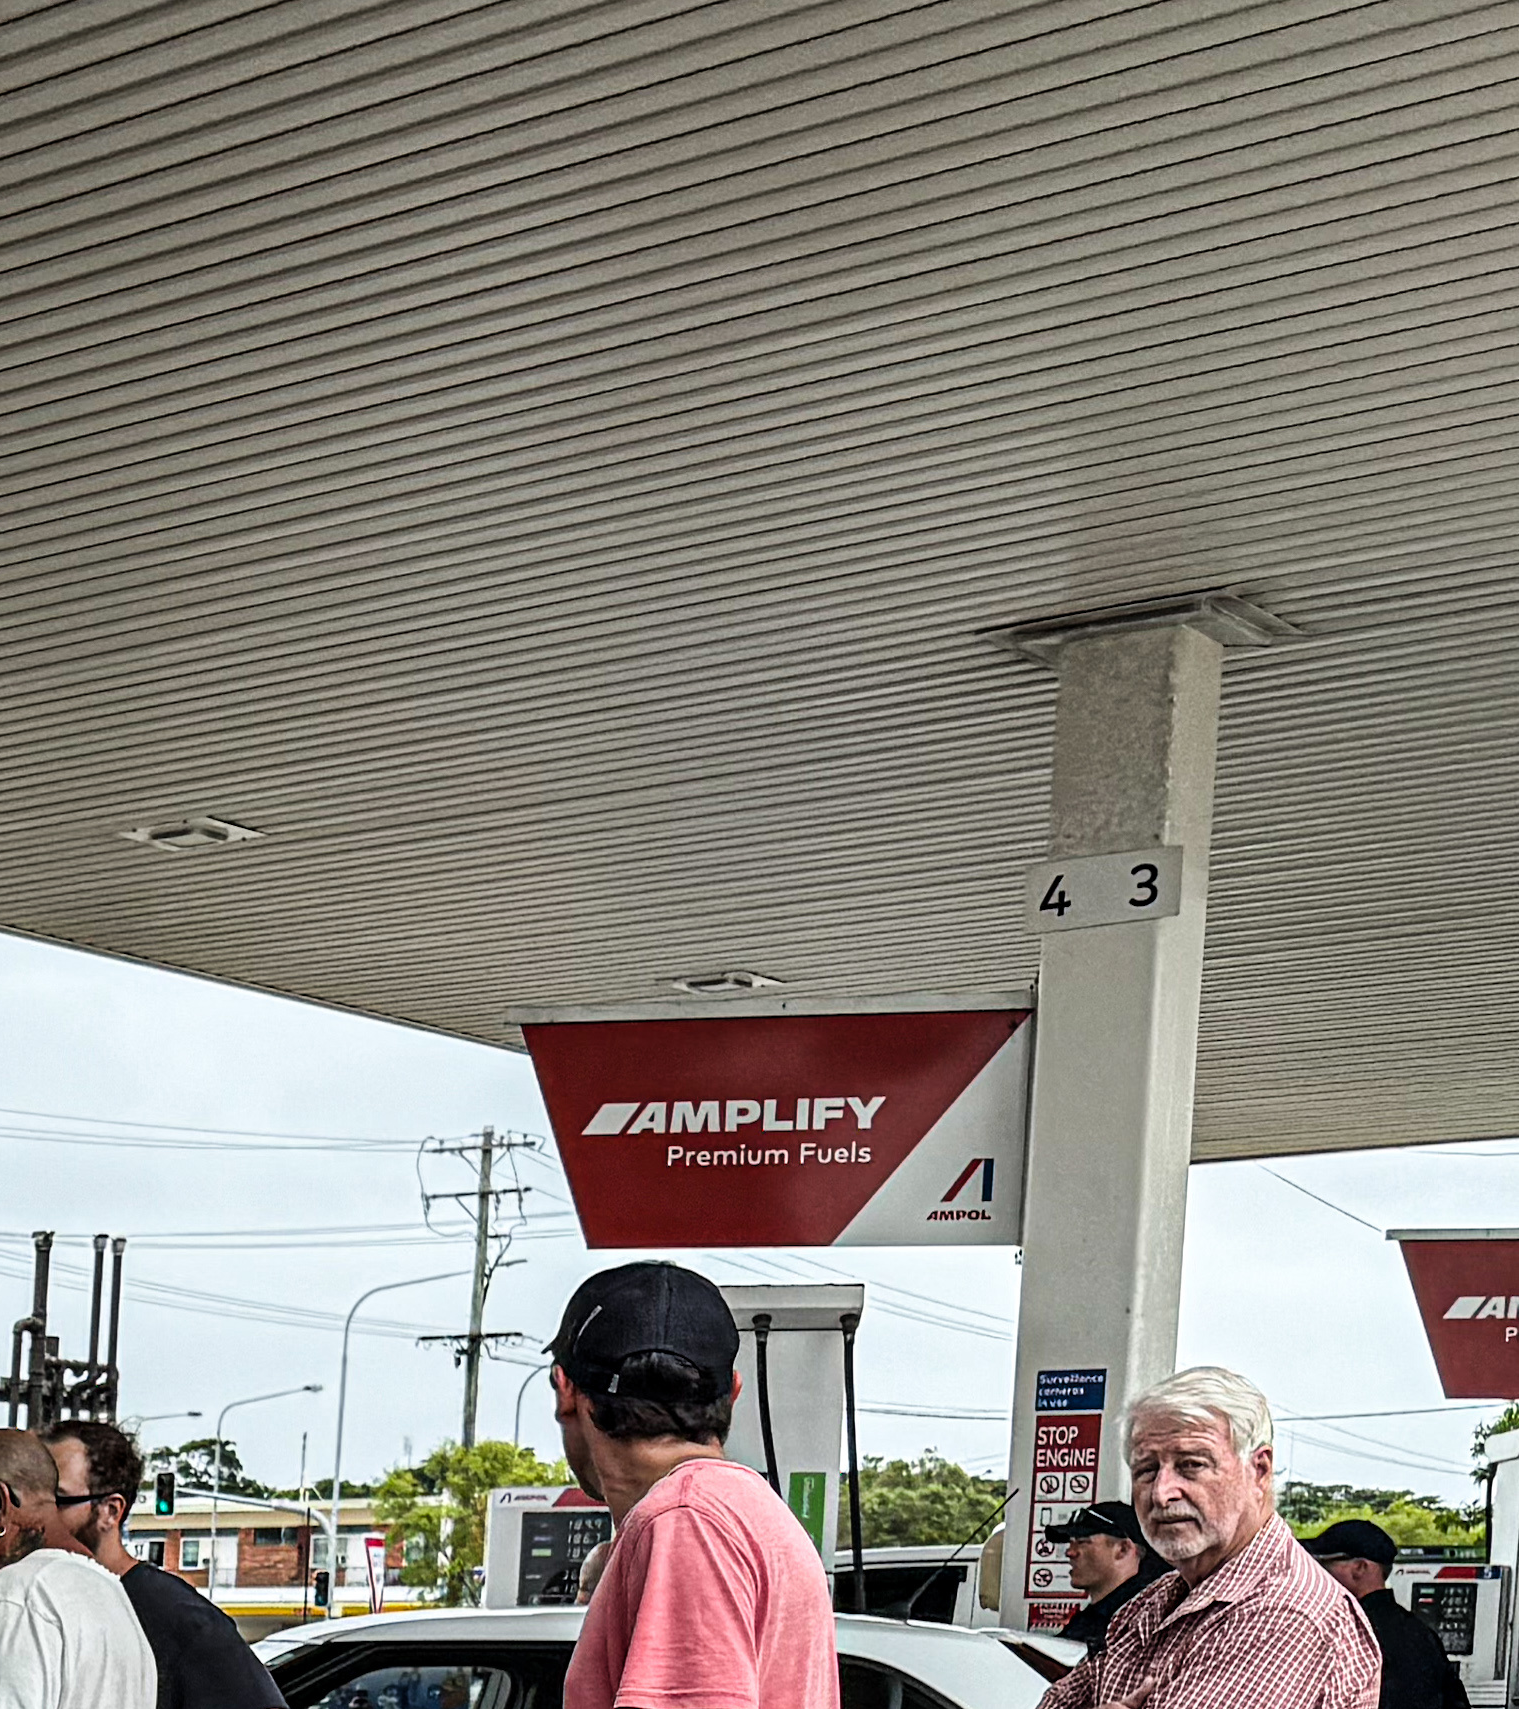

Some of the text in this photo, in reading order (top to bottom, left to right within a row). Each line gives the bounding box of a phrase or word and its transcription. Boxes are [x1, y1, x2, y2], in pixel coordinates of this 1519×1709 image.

[1039, 863, 1158, 916] 4 3
[626, 1096, 886, 1135] AMPLIFY
[667, 1141, 871, 1167] Premium Fuels
[926, 1208, 992, 1220] AMPOL
[1039, 1374, 1104, 1385] Surveillance
[1037, 1426, 1079, 1446] STOP
[1036, 1448, 1096, 1467] ENGINE
